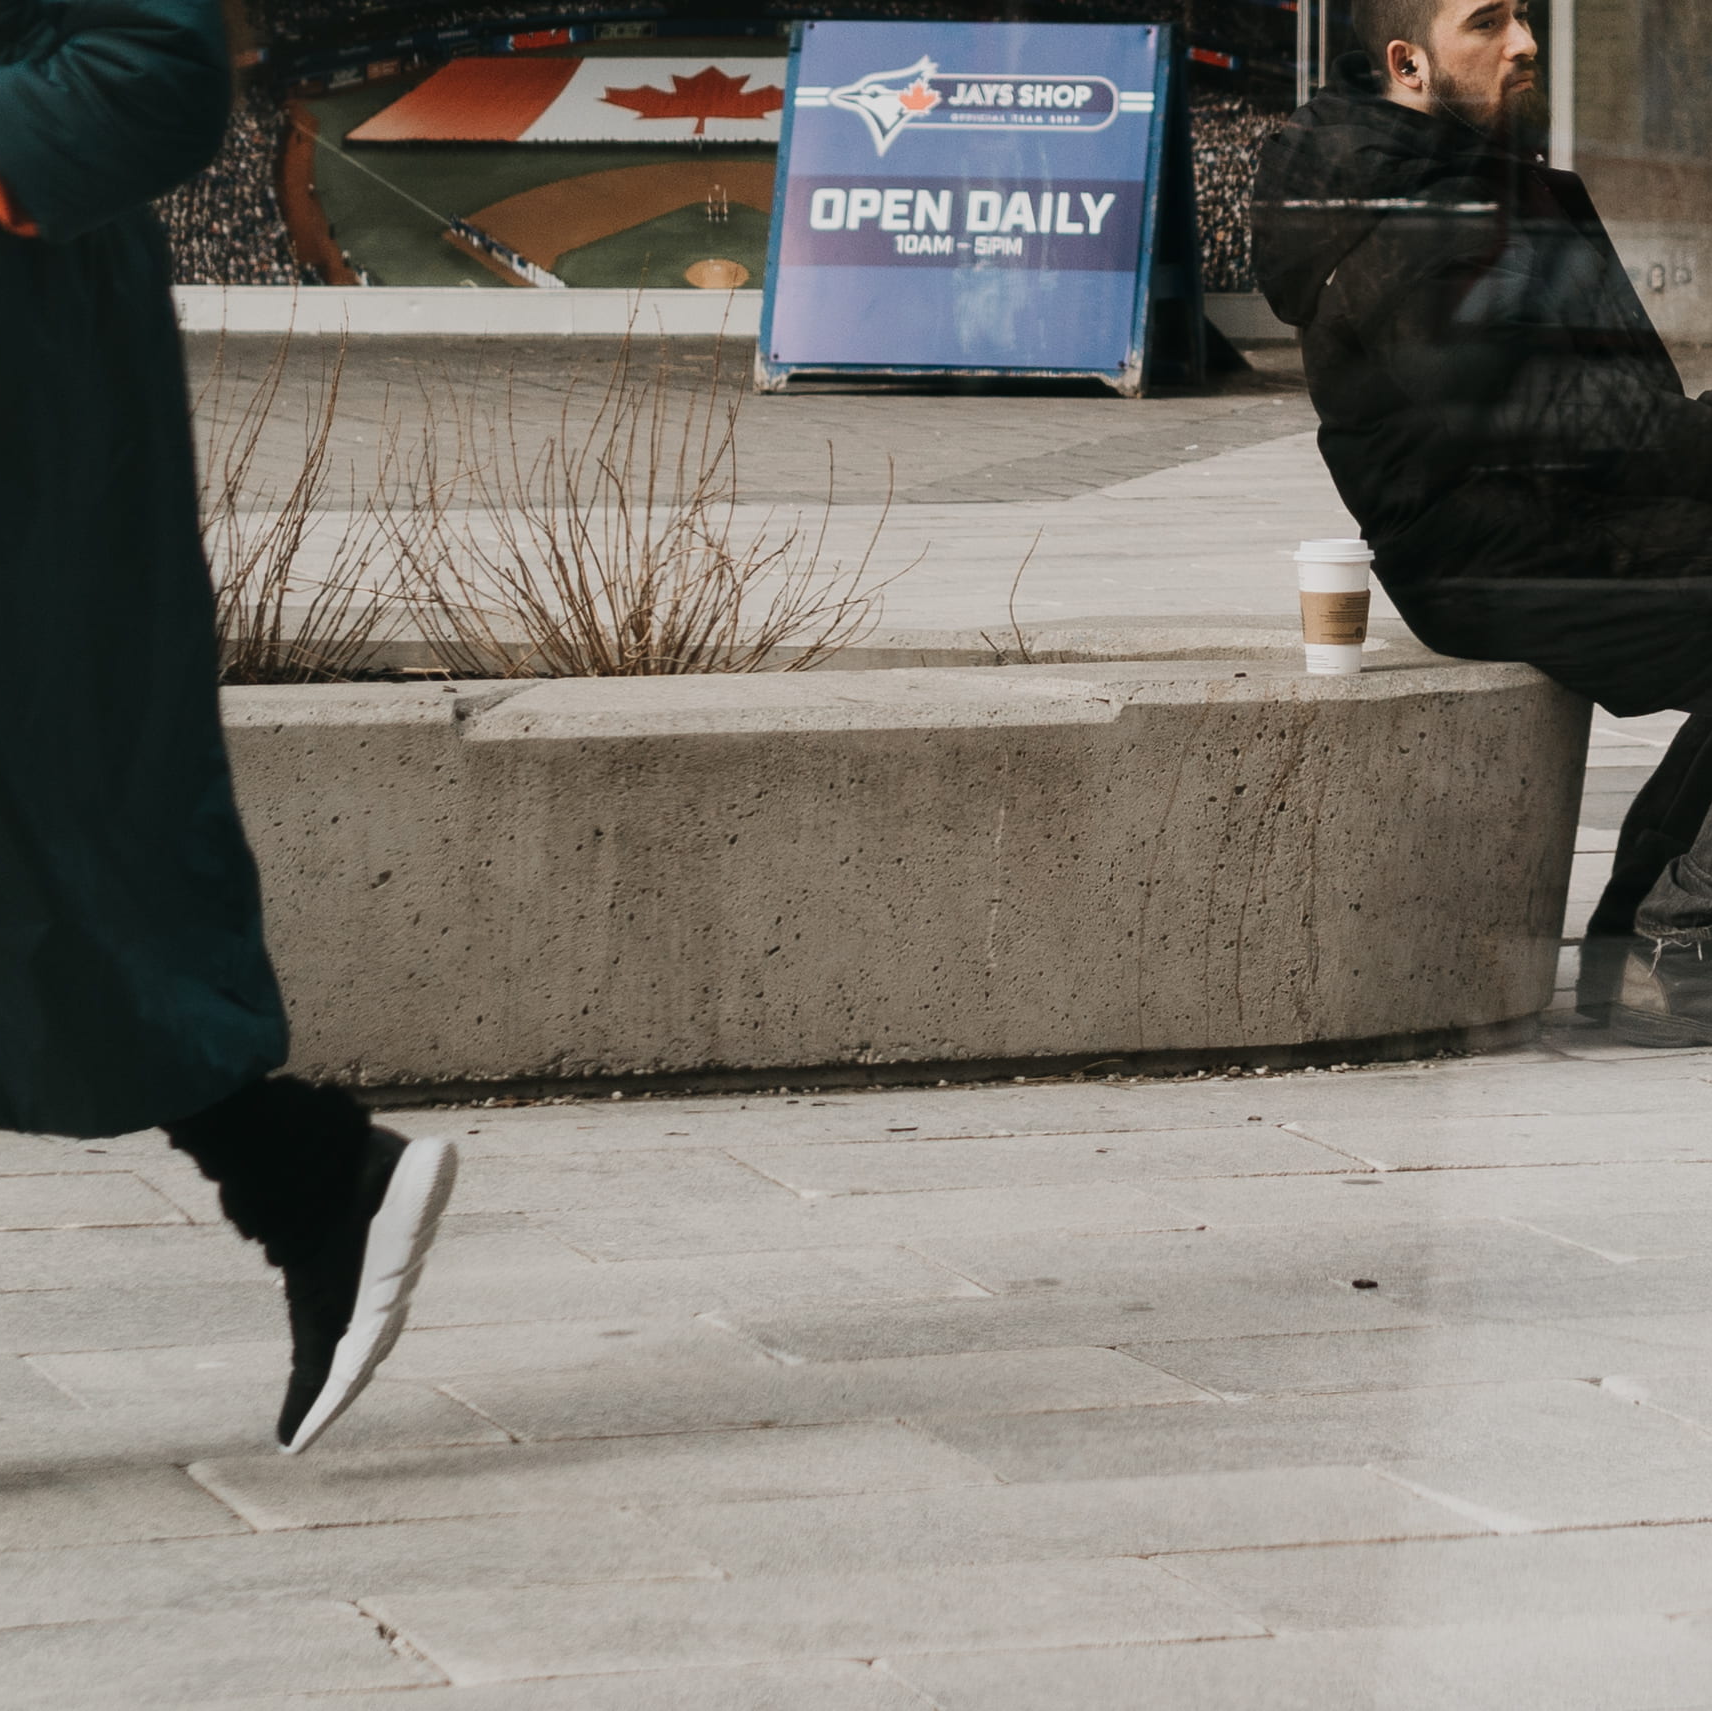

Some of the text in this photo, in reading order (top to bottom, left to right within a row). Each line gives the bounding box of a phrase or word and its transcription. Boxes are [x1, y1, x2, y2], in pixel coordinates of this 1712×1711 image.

[948, 83, 1093, 109] JAYS SHOP
[809, 188, 1116, 234] OPEN DAILY
[895, 234, 954, 256] 10AM
[974, 235, 1023, 256] 5PM
